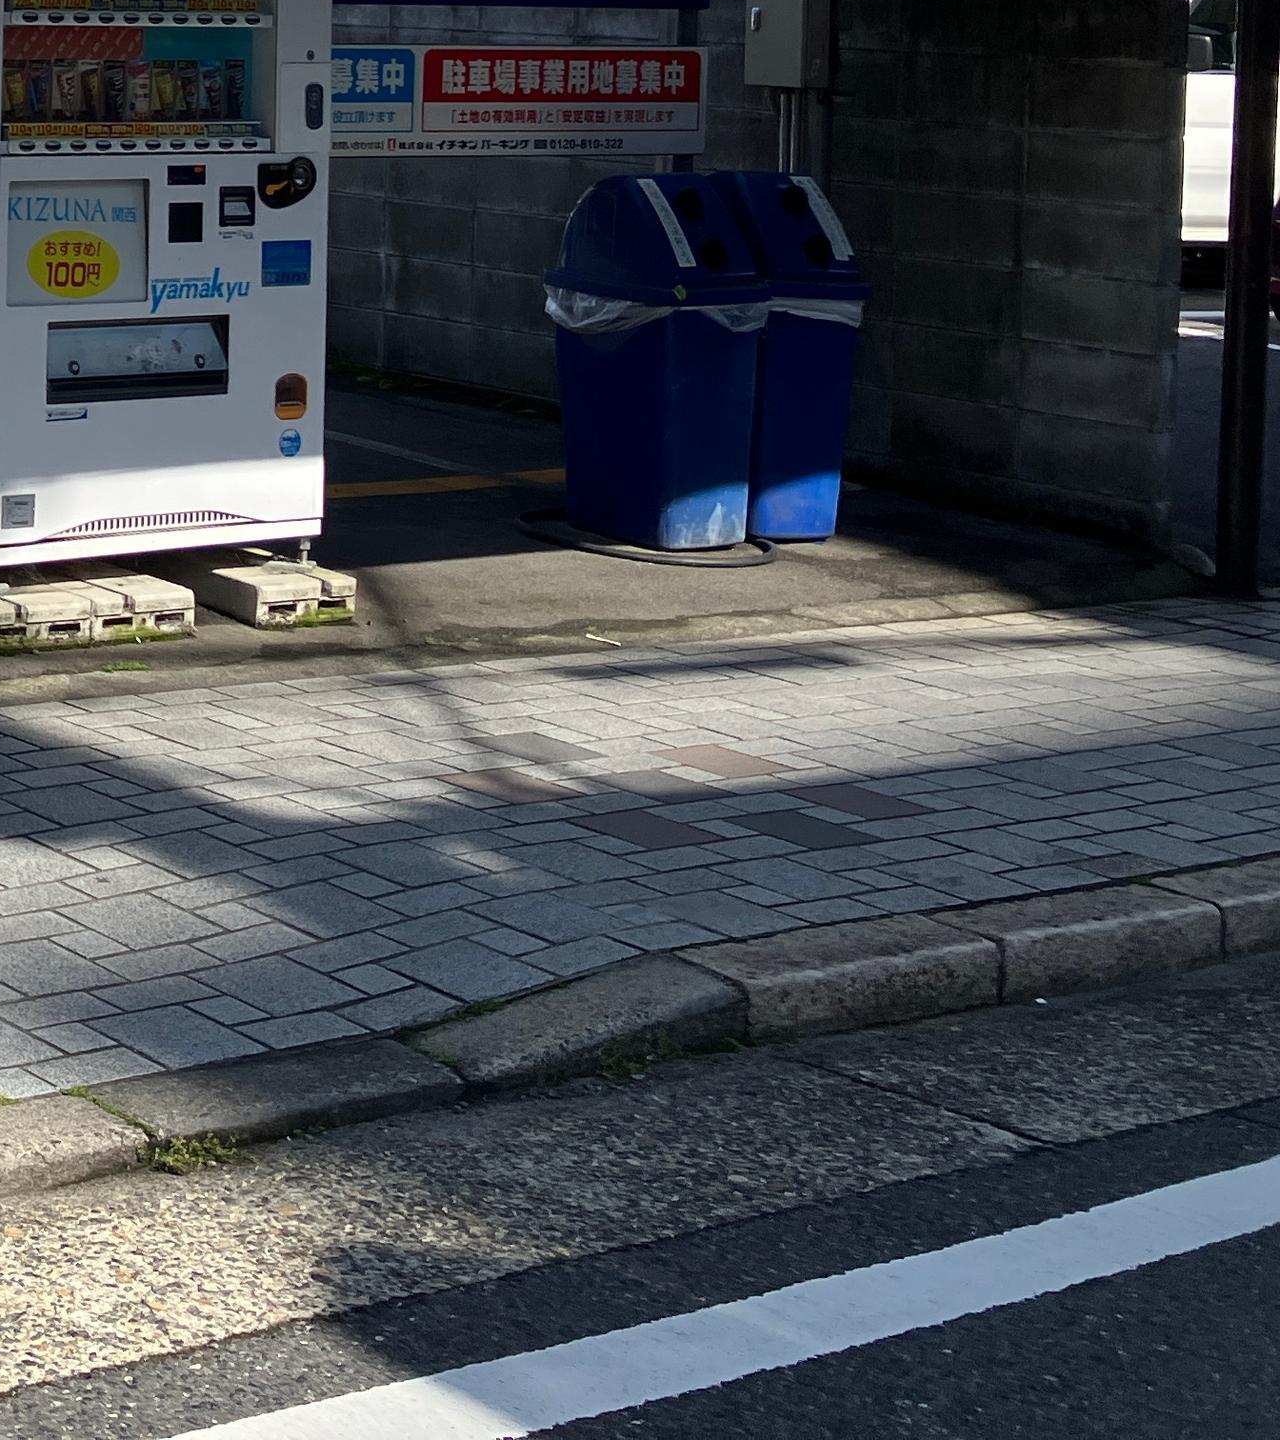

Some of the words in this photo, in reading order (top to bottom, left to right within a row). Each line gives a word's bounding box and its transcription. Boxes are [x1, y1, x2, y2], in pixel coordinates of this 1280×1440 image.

[442, 59, 686, 96] 駐車場事業用地募集中
[549, 138, 624, 150] 0120-810-322
[8, 197, 107, 222] KIZUNA
[150, 267, 250, 314] yamakyu
